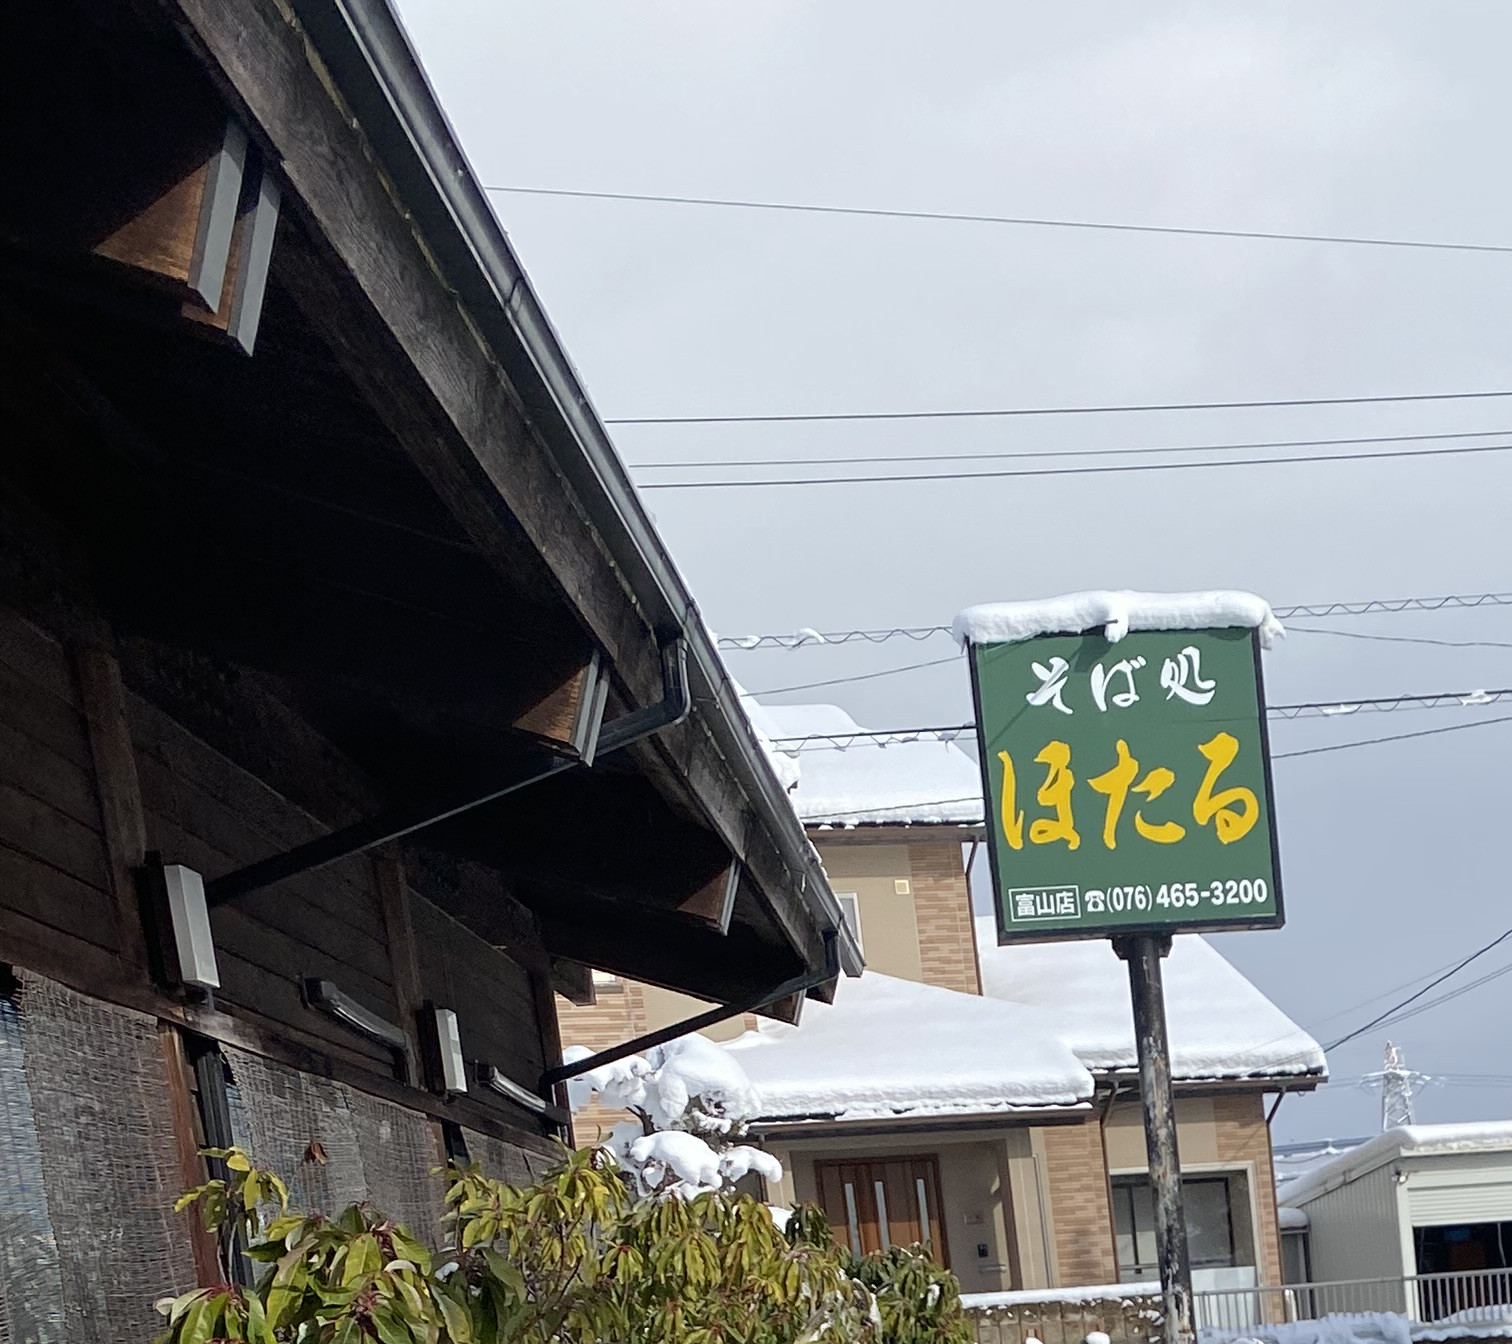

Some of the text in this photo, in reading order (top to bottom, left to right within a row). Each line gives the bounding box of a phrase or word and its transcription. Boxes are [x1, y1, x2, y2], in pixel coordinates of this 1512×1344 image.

[1025, 645, 1217, 715] そば処
[997, 731, 1260, 851] ほたる
[1015, 891, 1075, 917] 富山店
